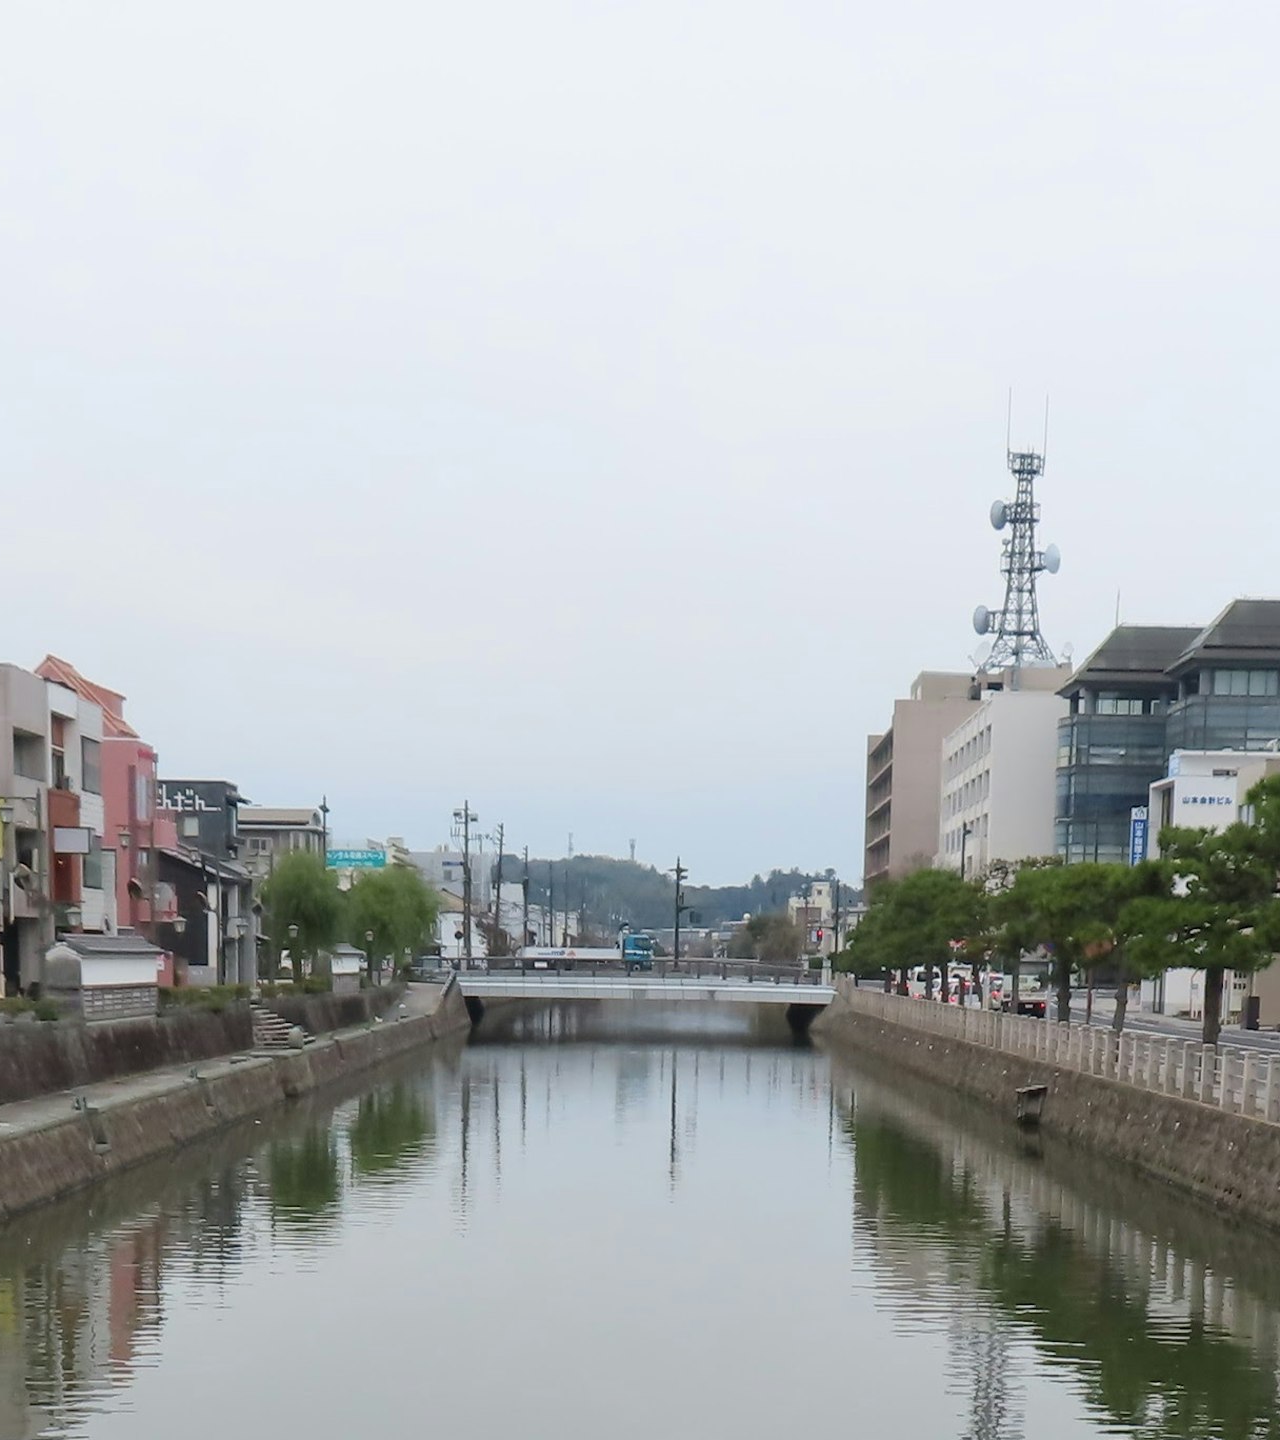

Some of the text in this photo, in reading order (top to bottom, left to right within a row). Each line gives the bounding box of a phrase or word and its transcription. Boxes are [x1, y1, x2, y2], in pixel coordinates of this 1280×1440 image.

[1182, 796, 1233, 805] 山本会計ビル
